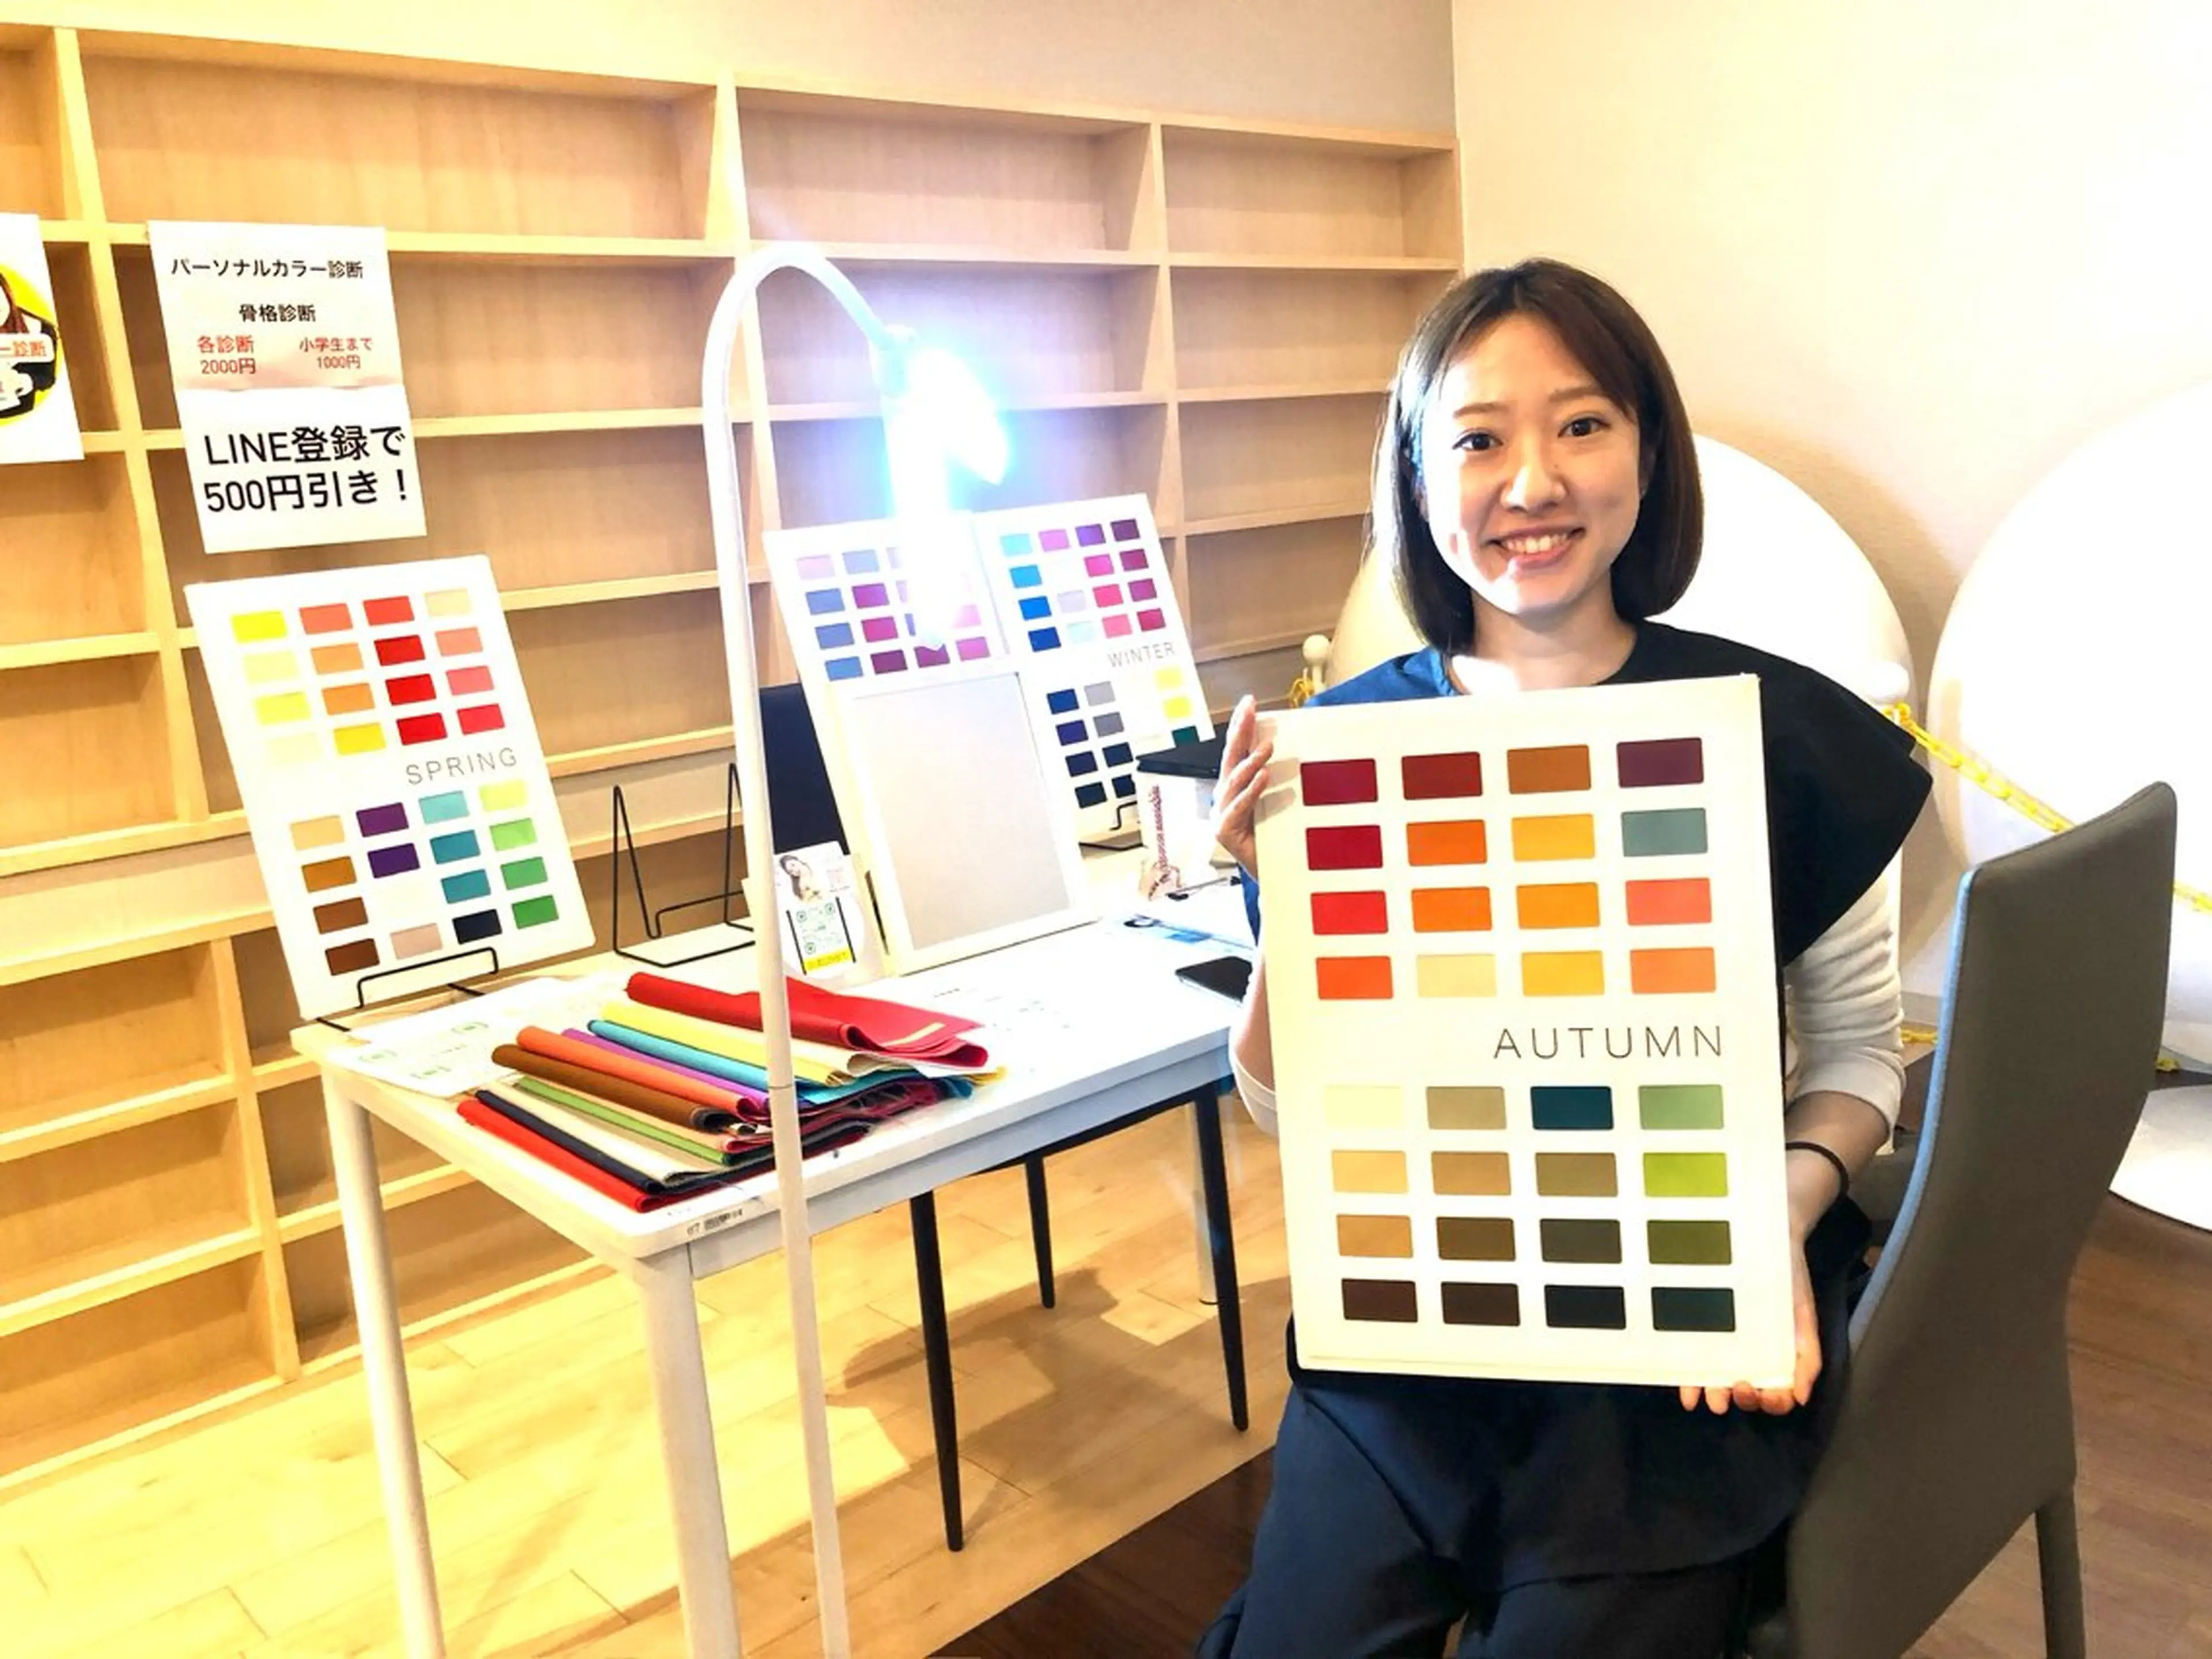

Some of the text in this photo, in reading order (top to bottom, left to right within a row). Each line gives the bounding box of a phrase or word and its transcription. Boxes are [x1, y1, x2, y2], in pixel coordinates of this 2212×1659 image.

[171, 258, 363, 279] パーソナルカラー診断
[239, 304, 316, 323] 骨格診断
[198, 335, 255, 354] 各診断
[299, 337, 373, 352] 小学生まで
[200, 357, 256, 374] 2000円
[316, 354, 361, 370] 1000円
[204, 425, 406, 465] LINE登録で
[1107, 642, 1175, 667] WINTER
[406, 747, 517, 785] SPRING
[1494, 1025, 1721, 1059] AUTUMN
